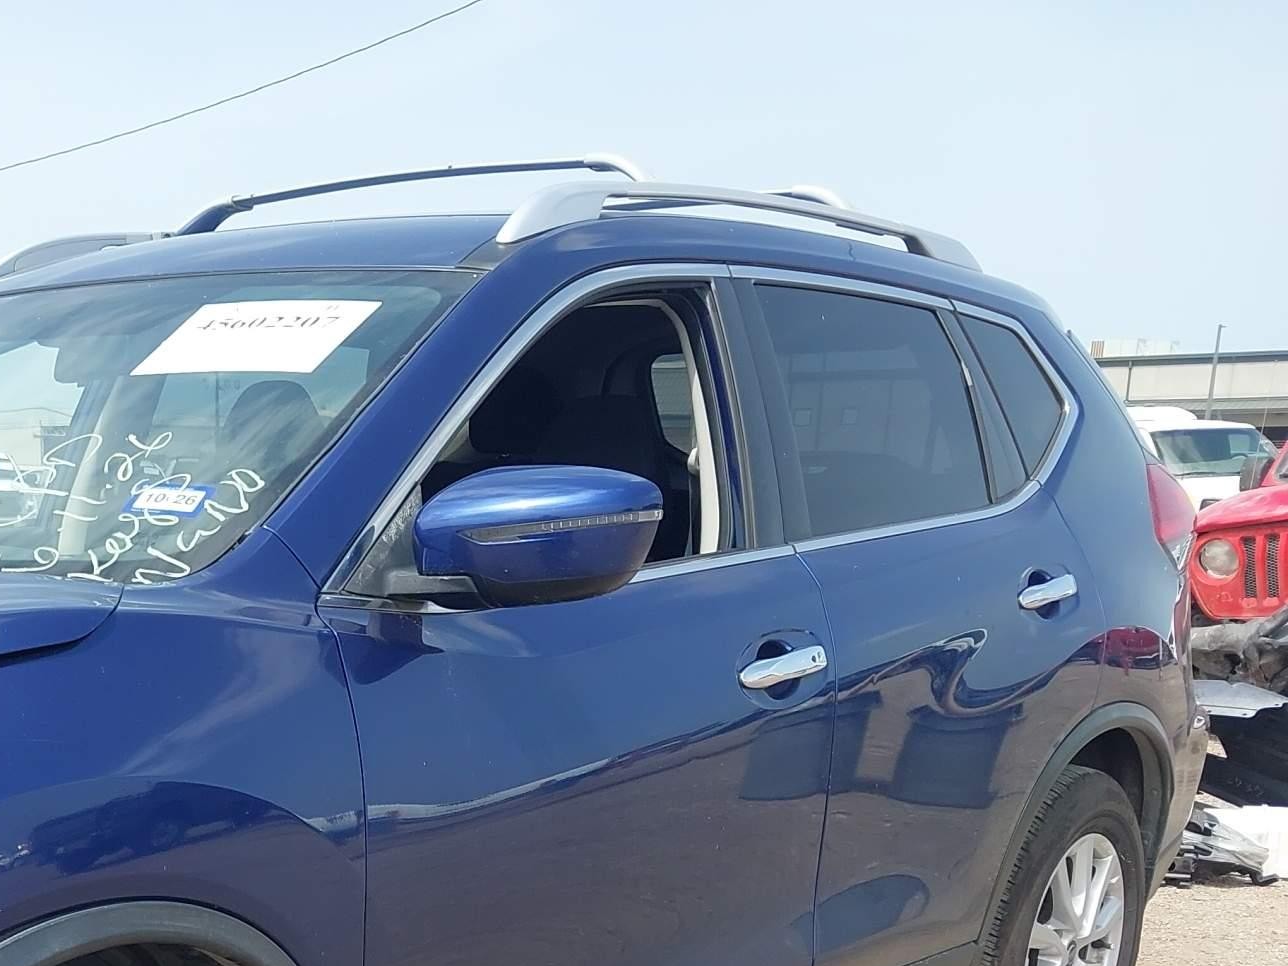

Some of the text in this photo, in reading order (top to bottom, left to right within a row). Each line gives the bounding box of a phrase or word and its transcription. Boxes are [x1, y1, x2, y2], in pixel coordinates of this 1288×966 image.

[197, 315, 342, 331] 45602207
[145, 492, 198, 505] 10 26
